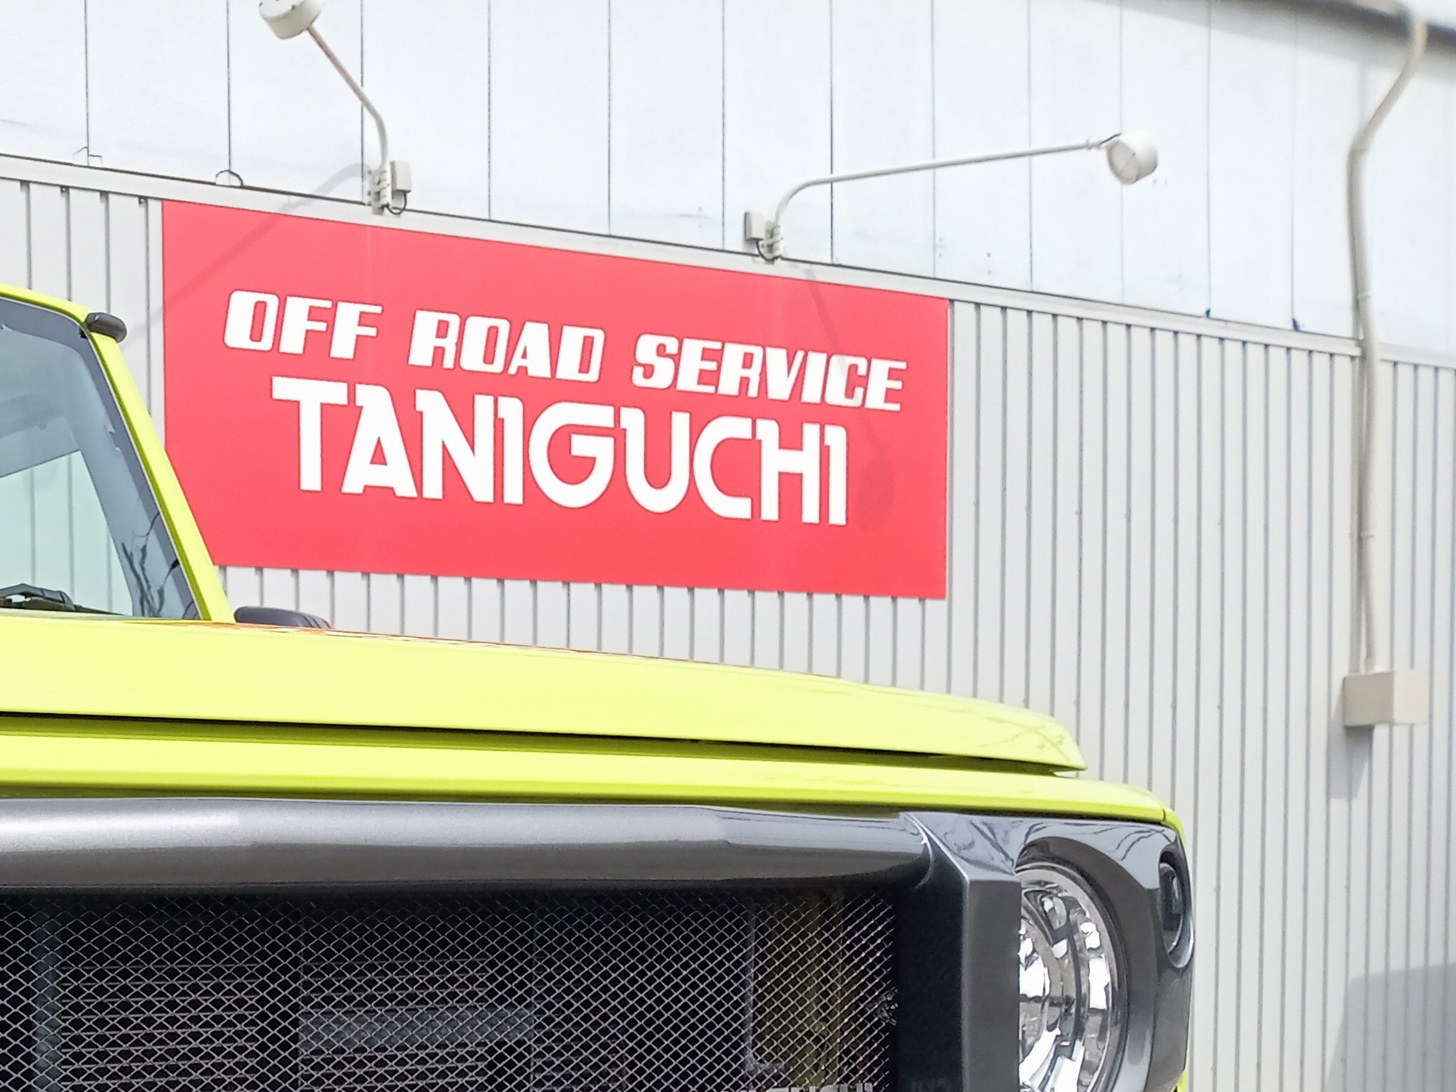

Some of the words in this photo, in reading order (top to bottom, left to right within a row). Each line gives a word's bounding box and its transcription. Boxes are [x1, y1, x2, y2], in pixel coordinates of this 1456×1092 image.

[224, 290, 384, 359] OFF
[407, 309, 606, 382] ROAD
[631, 333, 909, 412] SERVICE
[271, 375, 848, 526] TANIGUCHI
